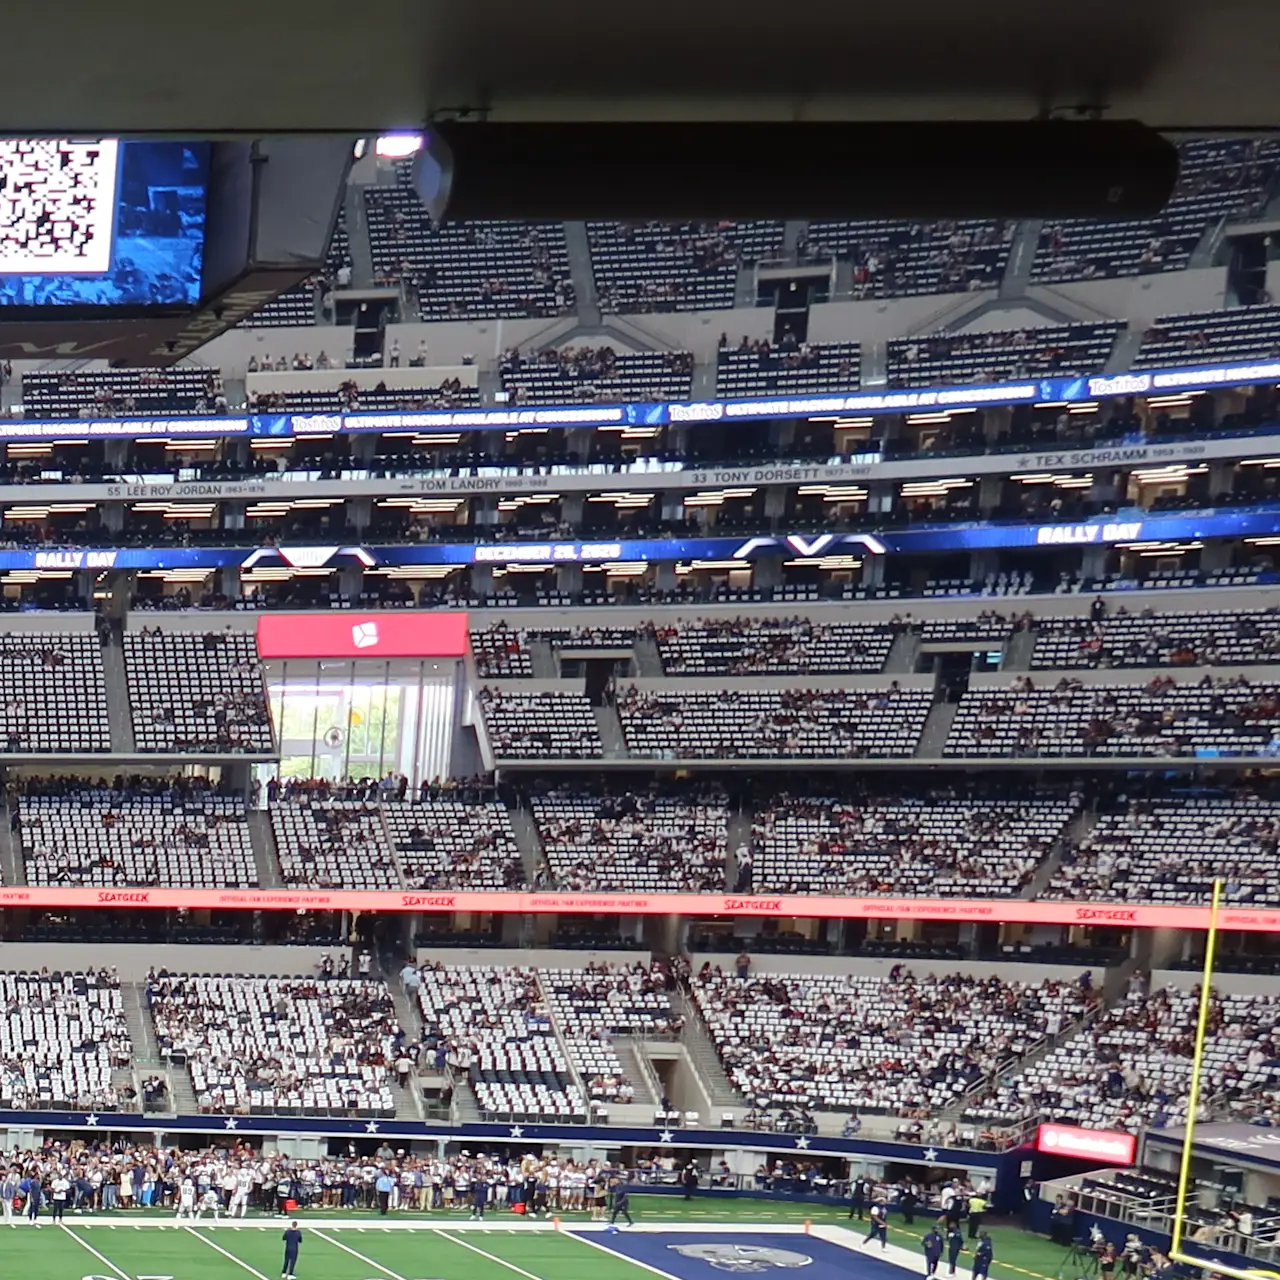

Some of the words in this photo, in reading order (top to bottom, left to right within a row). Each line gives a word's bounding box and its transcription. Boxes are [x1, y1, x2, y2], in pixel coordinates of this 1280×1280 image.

[1090, 376, 1148, 394] Tostitos
[670, 404, 721, 420] Tostitos
[293, 416, 339, 431] Tostitos
[1036, 456, 1064, 466] TEX
[1071, 450, 1147, 463] SCHRAMM
[714, 472, 749, 482] TONY
[755, 469, 819, 480] DORSETT
[127, 486, 145, 496] LEE
[149, 486, 172, 495] ROY
[177, 486, 221, 495] JORDAN
[420, 482, 445, 491] TOM
[451, 480, 500, 489] LANDRY
[1037, 525, 1100, 543] RALLY
[1103, 521, 1142, 541] DAY
[36, 552, 83, 567] RALLY
[87, 552, 117, 567] DAY
[476, 546, 551, 560] DECEMBER
[98, 893, 149, 903] SEATGEEK
[402, 897, 456, 906] SEATGEEK
[725, 900, 782, 910] SEATGEEK
[1076, 910, 1136, 920] SEATGEEK
